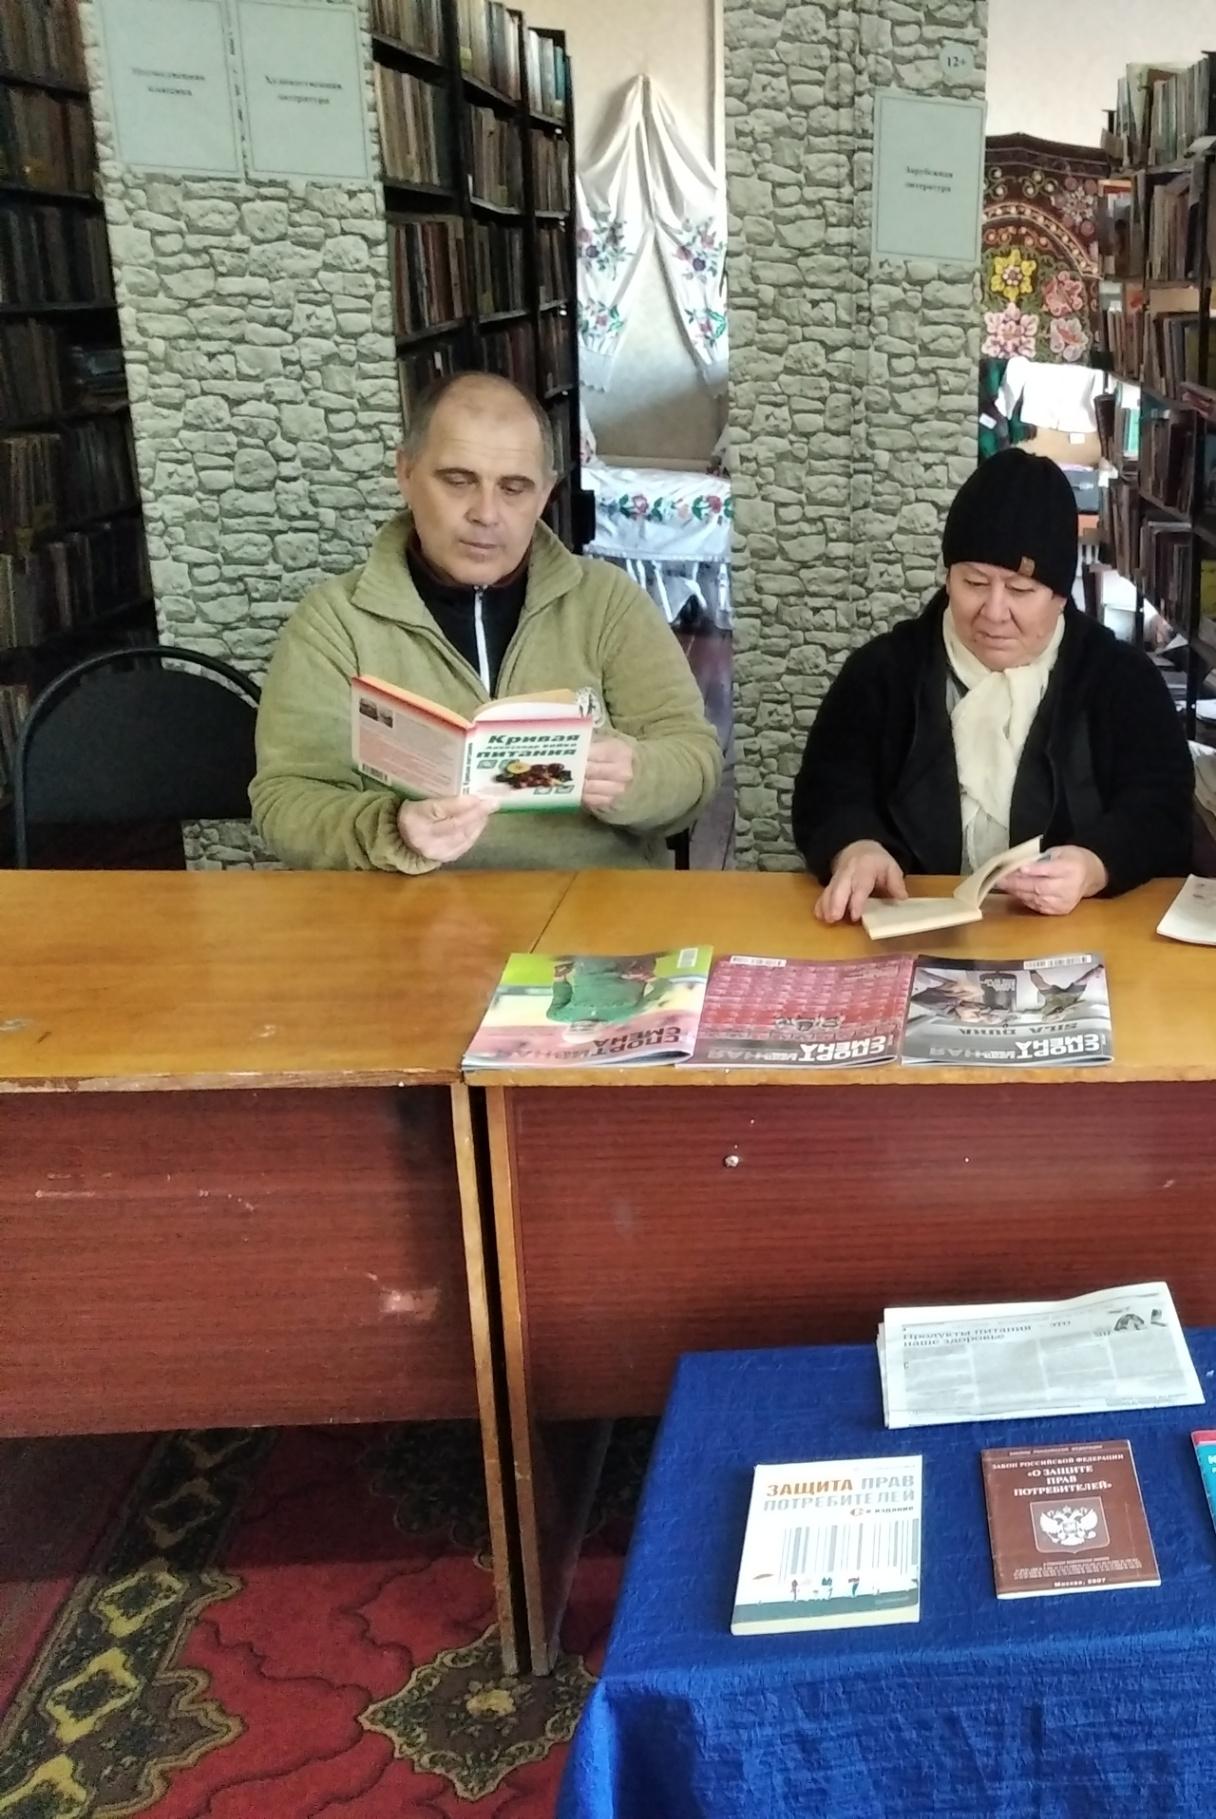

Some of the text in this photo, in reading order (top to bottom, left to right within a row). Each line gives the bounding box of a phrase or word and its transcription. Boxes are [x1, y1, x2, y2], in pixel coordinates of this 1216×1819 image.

[488, 734, 581, 746] Кривая
[476, 749, 577, 759] питания
[992, 1453, 1125, 1470] ЗАКОН РОССИЙСКОЙ ФЕДЕРАЦИИ
[1043, 1464, 1094, 1477] ЗАЩИТЕ
[766, 1475, 915, 1497] ЗАЩИТА ПРАВ
[1046, 1475, 1077, 1485] ПРАВ
[1013, 1479, 1113, 1497] ПОТРЕБИТЕЛЕЙ»
[763, 1489, 915, 1511] ПОТРЕБИТЕЛЕЙ
